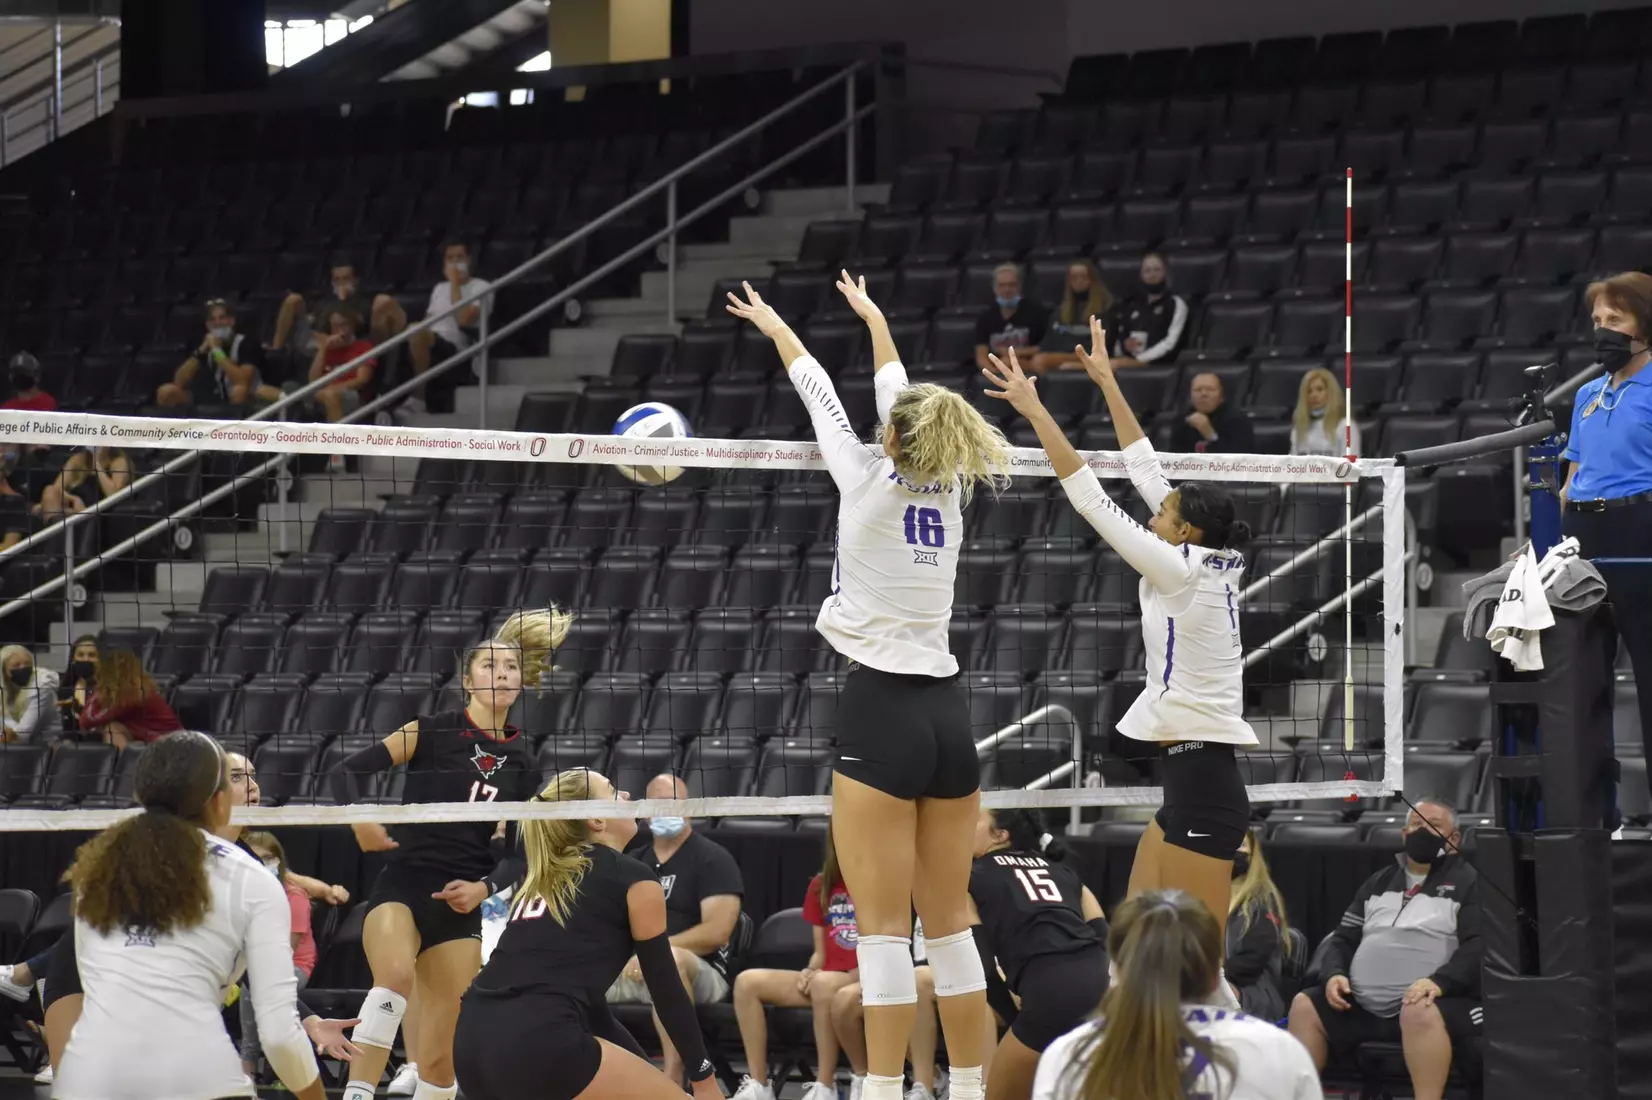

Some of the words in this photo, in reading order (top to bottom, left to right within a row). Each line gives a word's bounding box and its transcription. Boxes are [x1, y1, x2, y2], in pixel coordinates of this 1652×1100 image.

[20, 421, 31, 433] of
[33, 421, 64, 435] Public
[66, 423, 98, 436] Affairs
[100, 424, 108, 436] &
[110, 425, 167, 441] Community
[167, 427, 204, 440] Service
[210, 428, 269, 444] Gerontology
[276, 430, 319, 443] Goodrich
[321, 432, 360, 445] Scholars
[366, 434, 394, 446] Public
[395, 435, 462, 449] Administration
[468, 438, 496, 450] Social
[498, 439, 521, 451] Work
[592, 443, 627, 455] Aviation
[634, 444, 669, 456] Criminal
[670, 446, 699, 457] Justice
[706, 447, 773, 462] Multidisciplinary
[775, 449, 803, 461] Studies
[1173, 460, 1204, 471] Scholars
[1209, 461, 1231, 472] Public
[1231, 462, 1282, 474] Administration
[1286, 463, 1307, 474] Social
[902, 503, 946, 549] 16
[1168, 744, 1184, 756] NIKE
[1185, 740, 1204, 751] PRO
[993, 855, 1050, 868] OMAHA
[1013, 867, 1064, 903] 15
